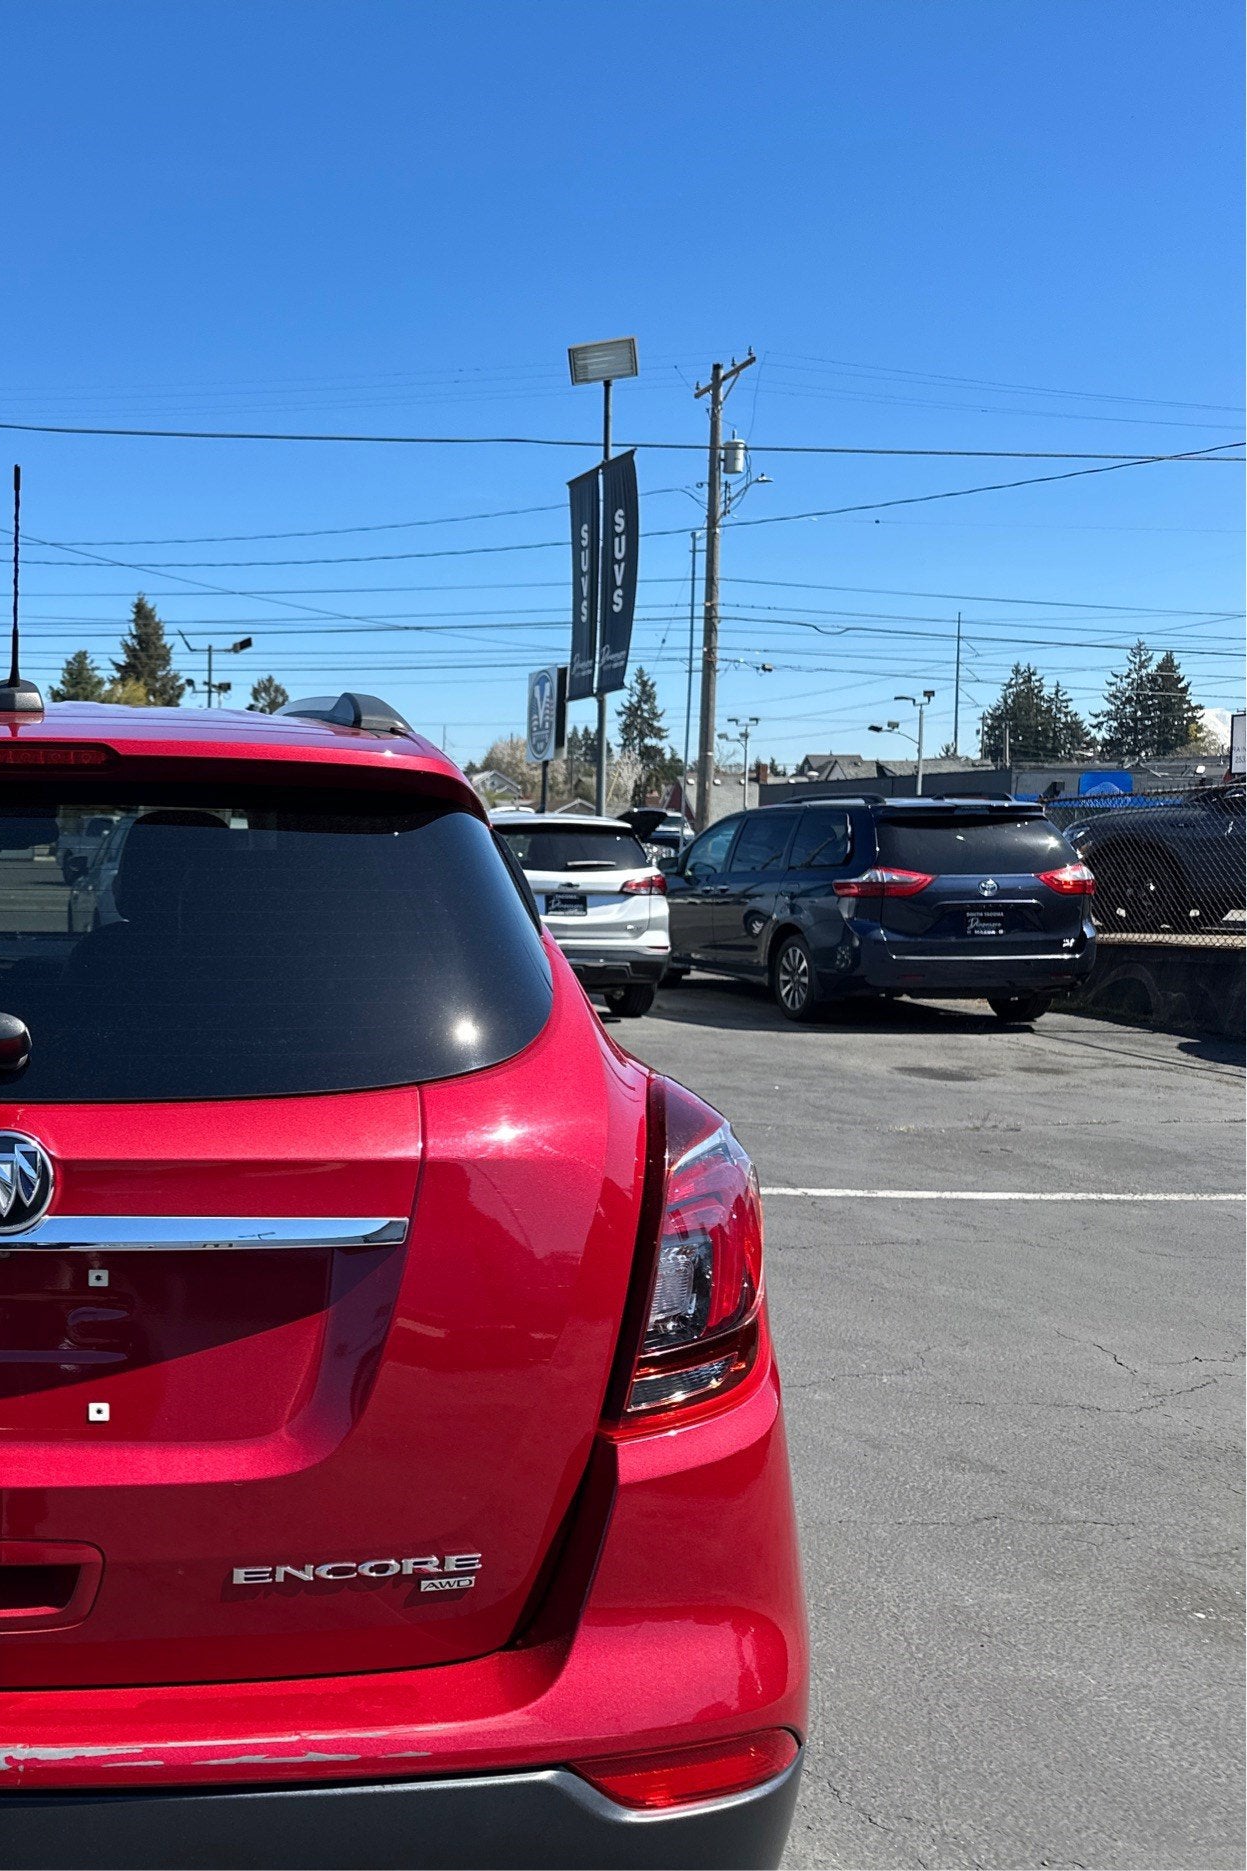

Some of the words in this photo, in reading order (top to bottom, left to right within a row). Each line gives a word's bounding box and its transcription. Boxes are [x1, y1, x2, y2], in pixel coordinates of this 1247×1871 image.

[580, 523, 589, 623] SUVS
[612, 508, 625, 614] SUVS
[232, 1553, 483, 1584] ENCORE
[422, 1577, 473, 1591] AWD
